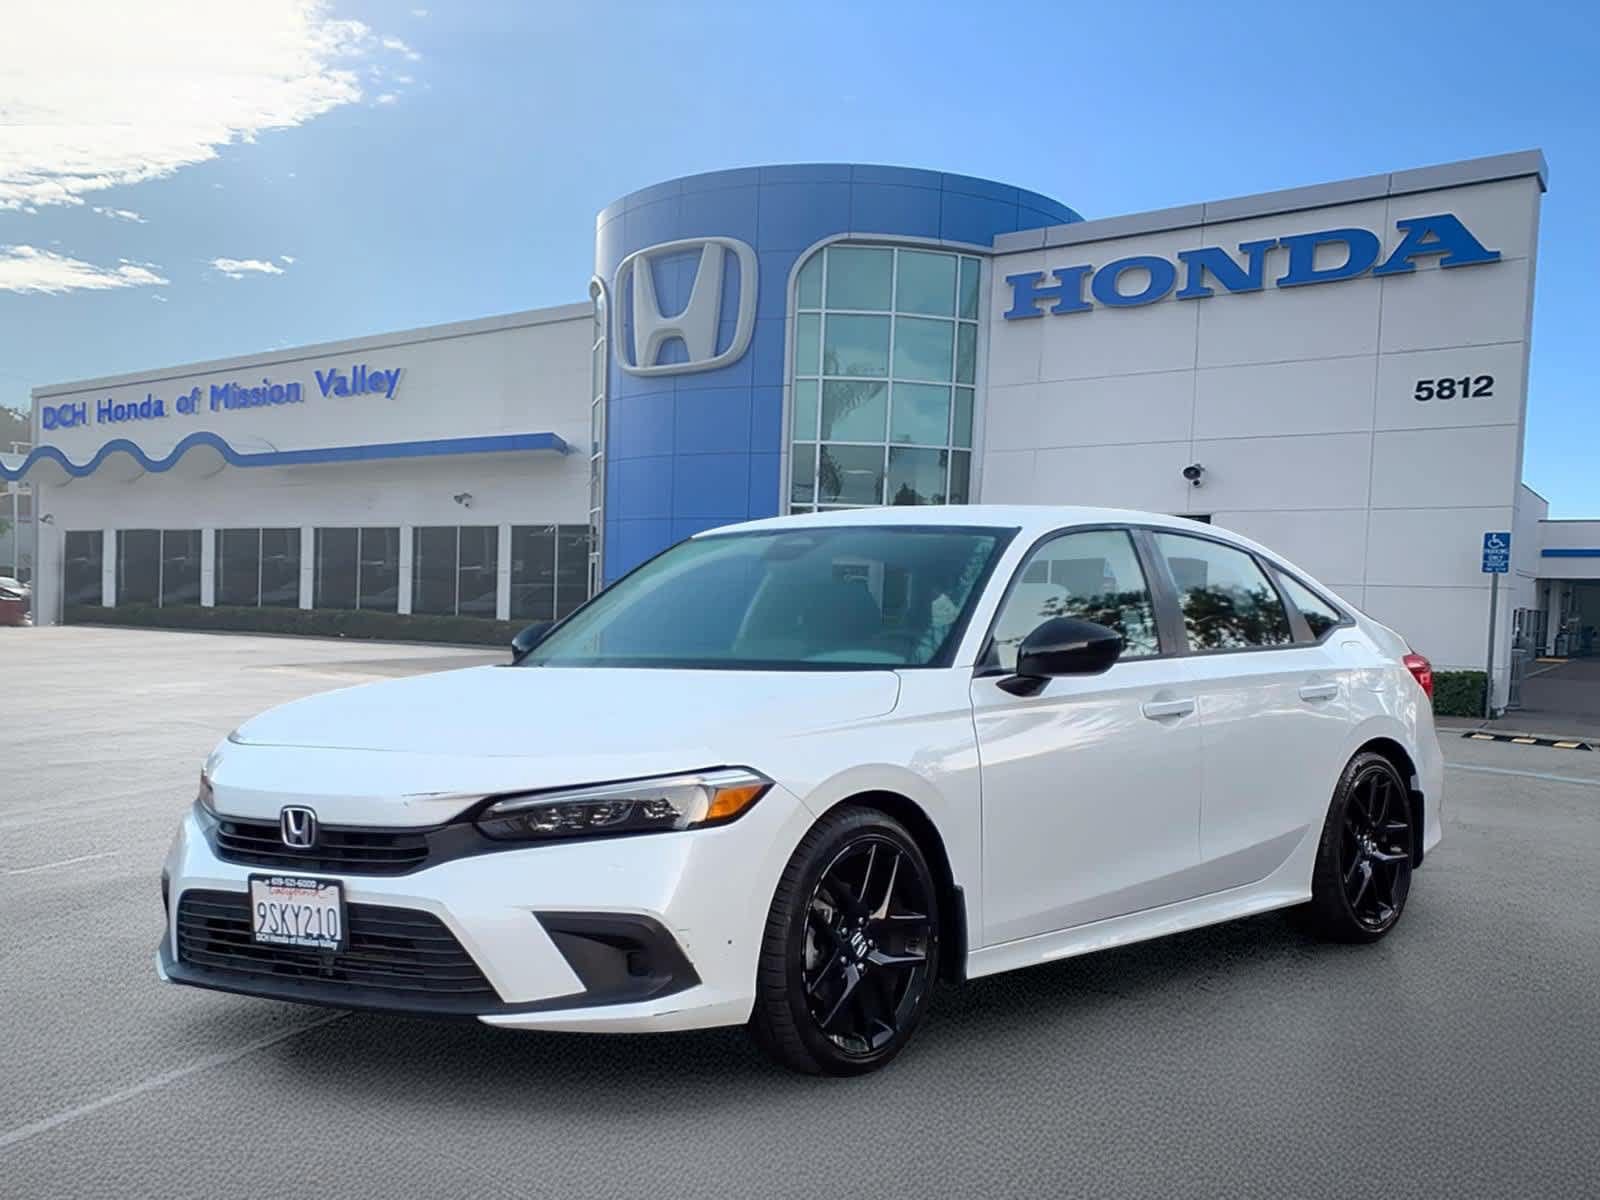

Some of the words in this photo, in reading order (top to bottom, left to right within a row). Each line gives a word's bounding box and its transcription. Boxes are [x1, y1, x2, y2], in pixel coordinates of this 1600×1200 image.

[1003, 212, 1502, 320] HONDA
[42, 403, 87, 431] DCH
[96, 394, 166, 423] Honda
[175, 387, 201, 415] of
[209, 378, 303, 411] Mission
[314, 364, 402, 400] Valley
[1414, 375, 1495, 402] 5812
[257, 901, 338, 939] 9SKY210
